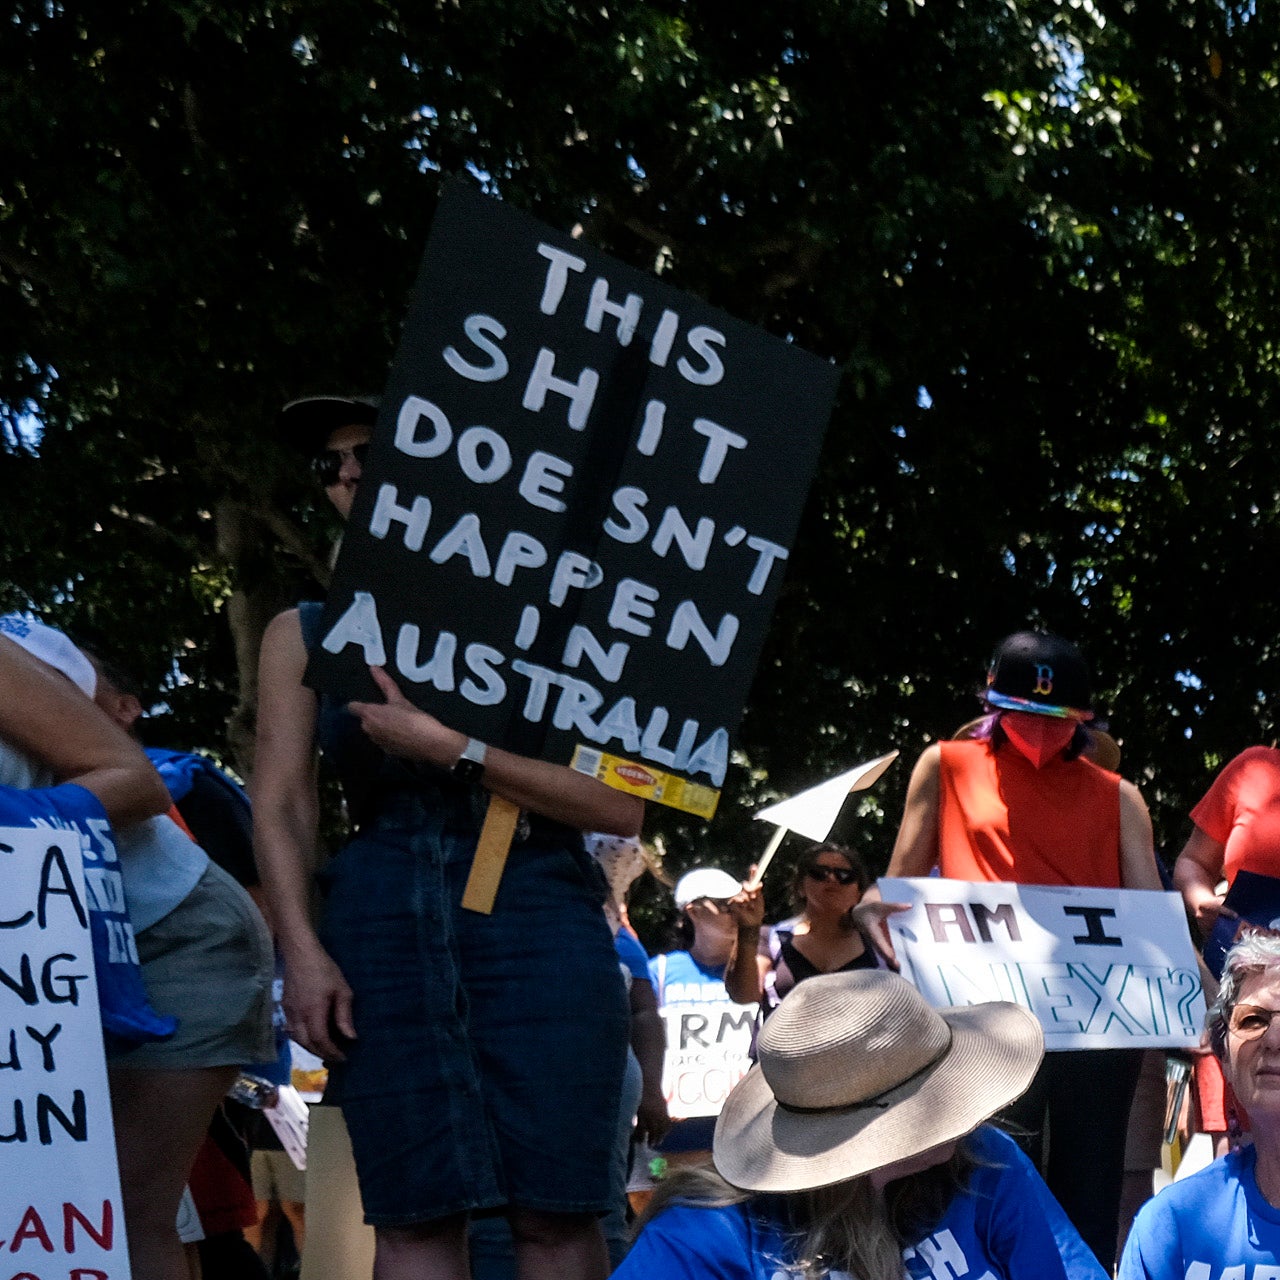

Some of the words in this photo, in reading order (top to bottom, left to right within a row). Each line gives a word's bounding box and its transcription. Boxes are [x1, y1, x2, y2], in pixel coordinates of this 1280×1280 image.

[442, 314, 748, 484] SHIT
[537, 242, 726, 386] THIS
[369, 483, 740, 667] HAPPEN
[394, 395, 790, 596] DOESN'T
[321, 591, 729, 787] AUSTRALIA
[515, 604, 630, 683] IN
[924, 903, 1022, 943] AM
[1063, 905, 1123, 947] I
